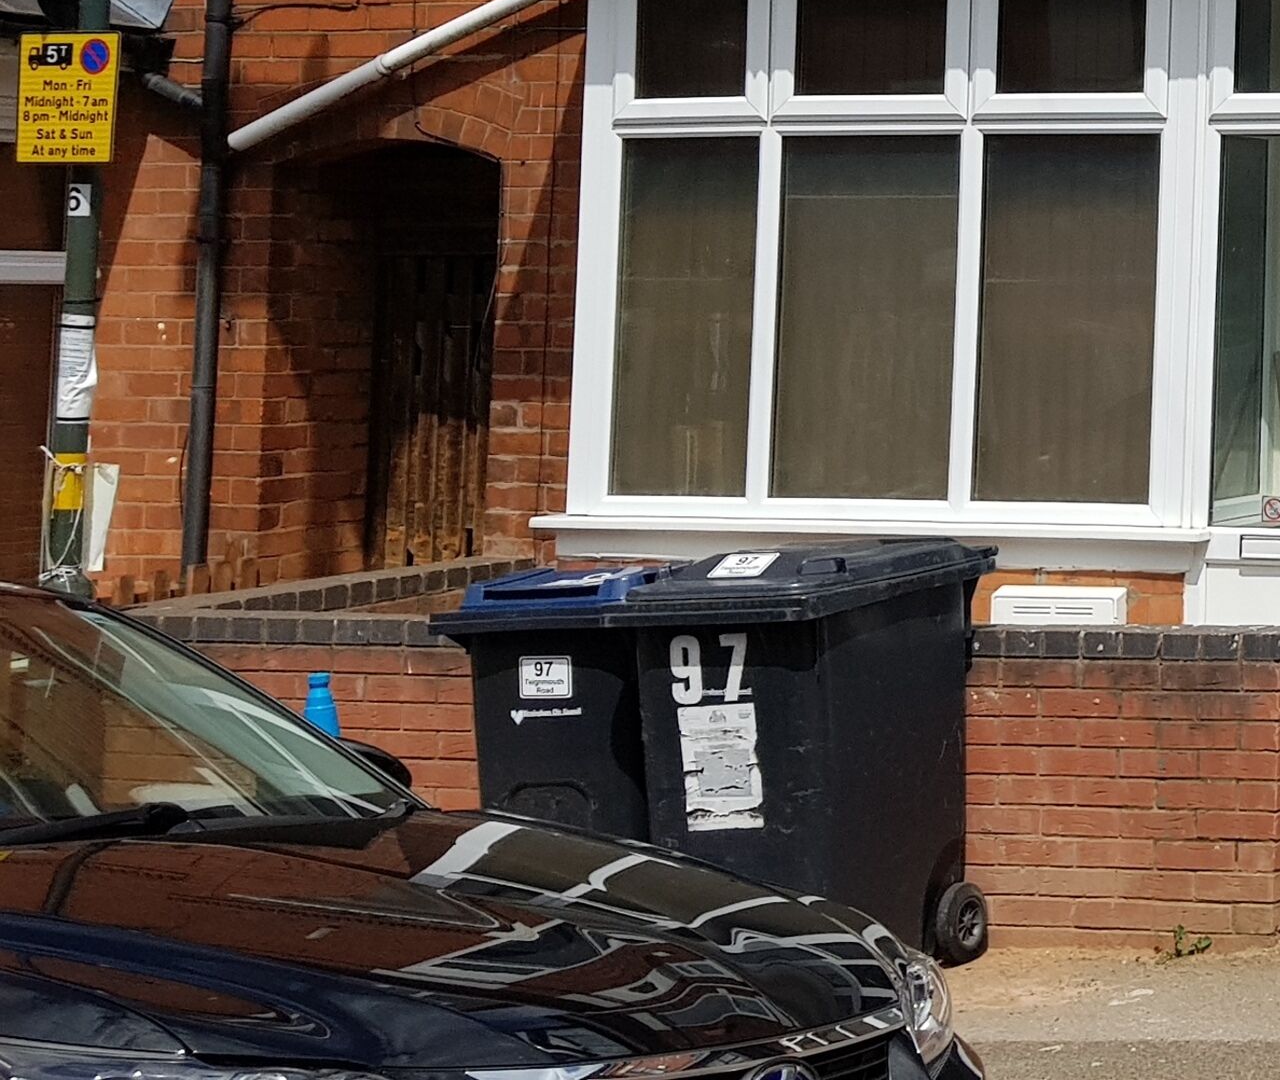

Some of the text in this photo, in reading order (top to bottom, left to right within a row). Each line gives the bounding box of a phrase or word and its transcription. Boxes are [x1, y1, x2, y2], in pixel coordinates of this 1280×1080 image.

[46, 45, 68, 63] 5T
[43, 80, 67, 91] Mon
[76, 79, 92, 91] Fri
[25, 96, 74, 109] Midnight
[59, 110, 108, 123] Midnight
[36, 128, 93, 139] Sat & Sun
[31, 145, 96, 158] At any time
[736, 556, 760, 566] 97
[534, 661, 553, 677] 97
[669, 632, 748, 706] 97
